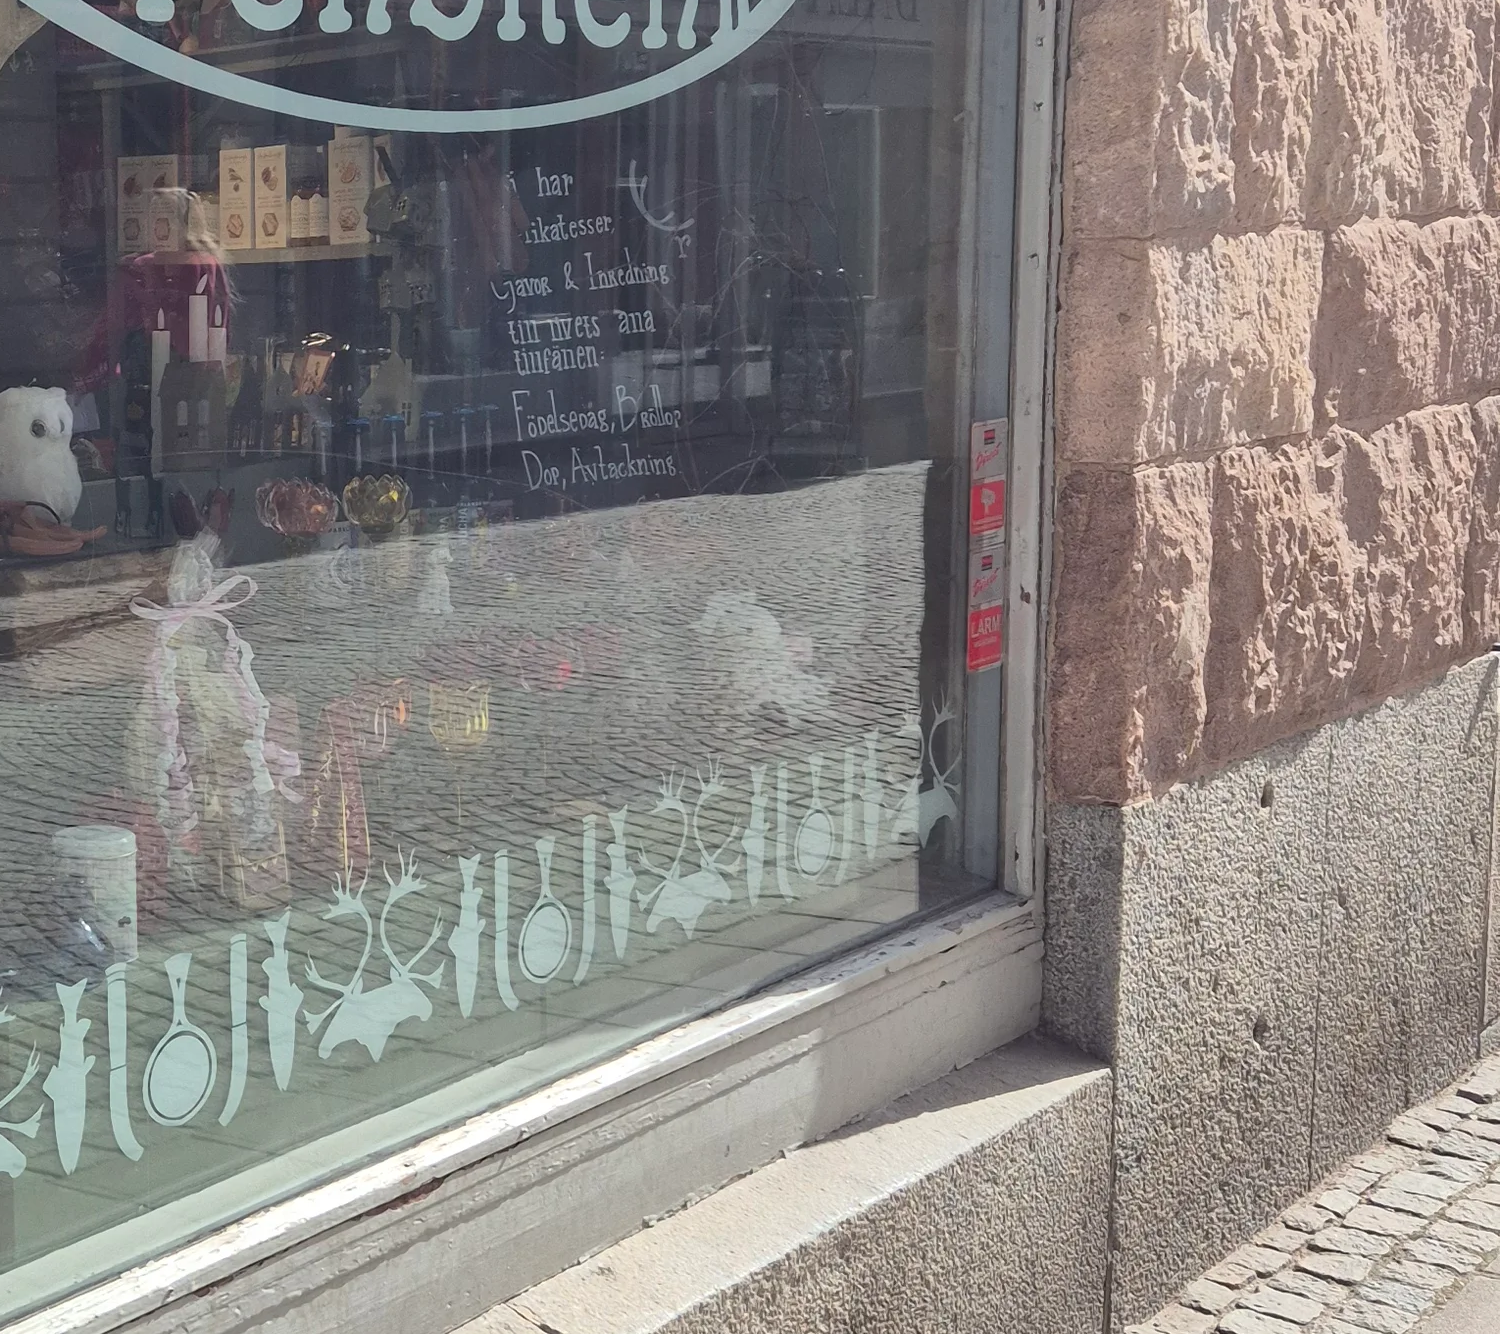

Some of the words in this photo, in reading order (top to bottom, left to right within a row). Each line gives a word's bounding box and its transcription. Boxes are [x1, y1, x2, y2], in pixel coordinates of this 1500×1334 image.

[535, 166, 574, 197] har
[524, 214, 615, 245] ikatesser,
[563, 260, 580, 291] &
[971, 616, 1000, 638] LARM
